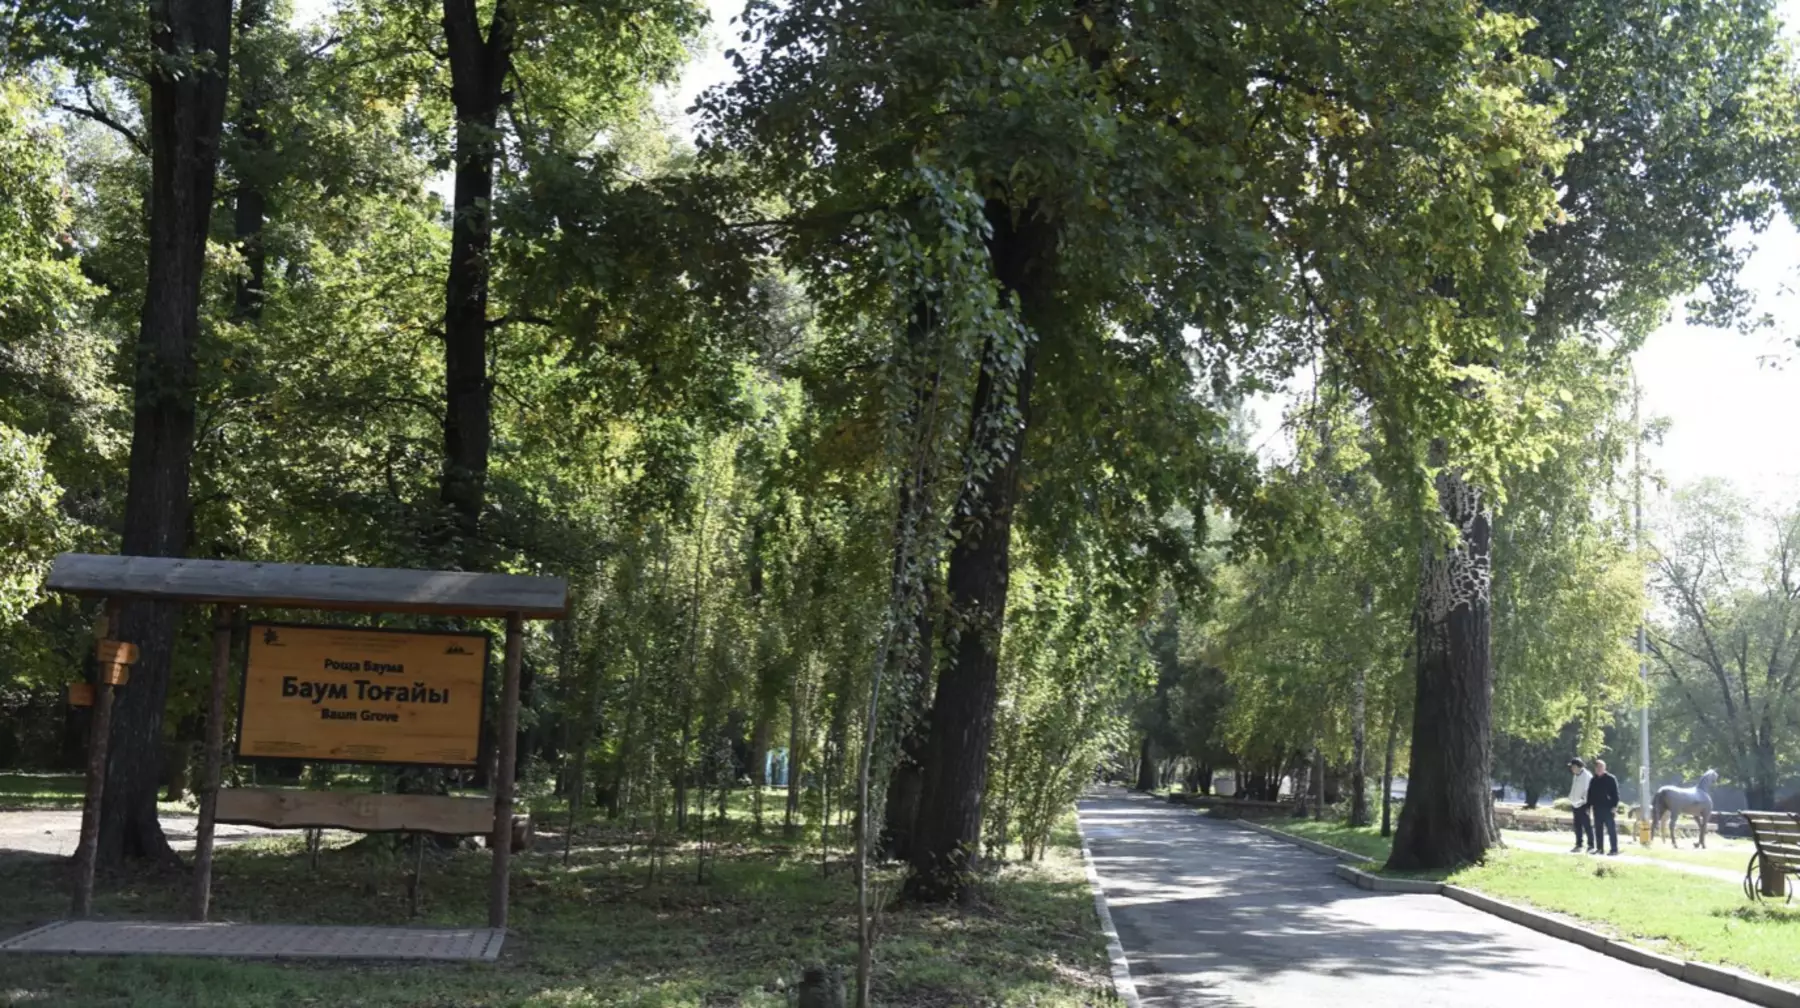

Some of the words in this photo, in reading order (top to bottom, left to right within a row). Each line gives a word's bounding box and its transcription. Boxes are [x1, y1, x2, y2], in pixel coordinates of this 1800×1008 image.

[324, 658, 360, 673] Роща
[364, 660, 404, 675] Баума
[282, 676, 347, 704] Баум
[354, 680, 449, 704] Тоғайы
[321, 708, 357, 721] Baum
[361, 710, 399, 722] Grove
